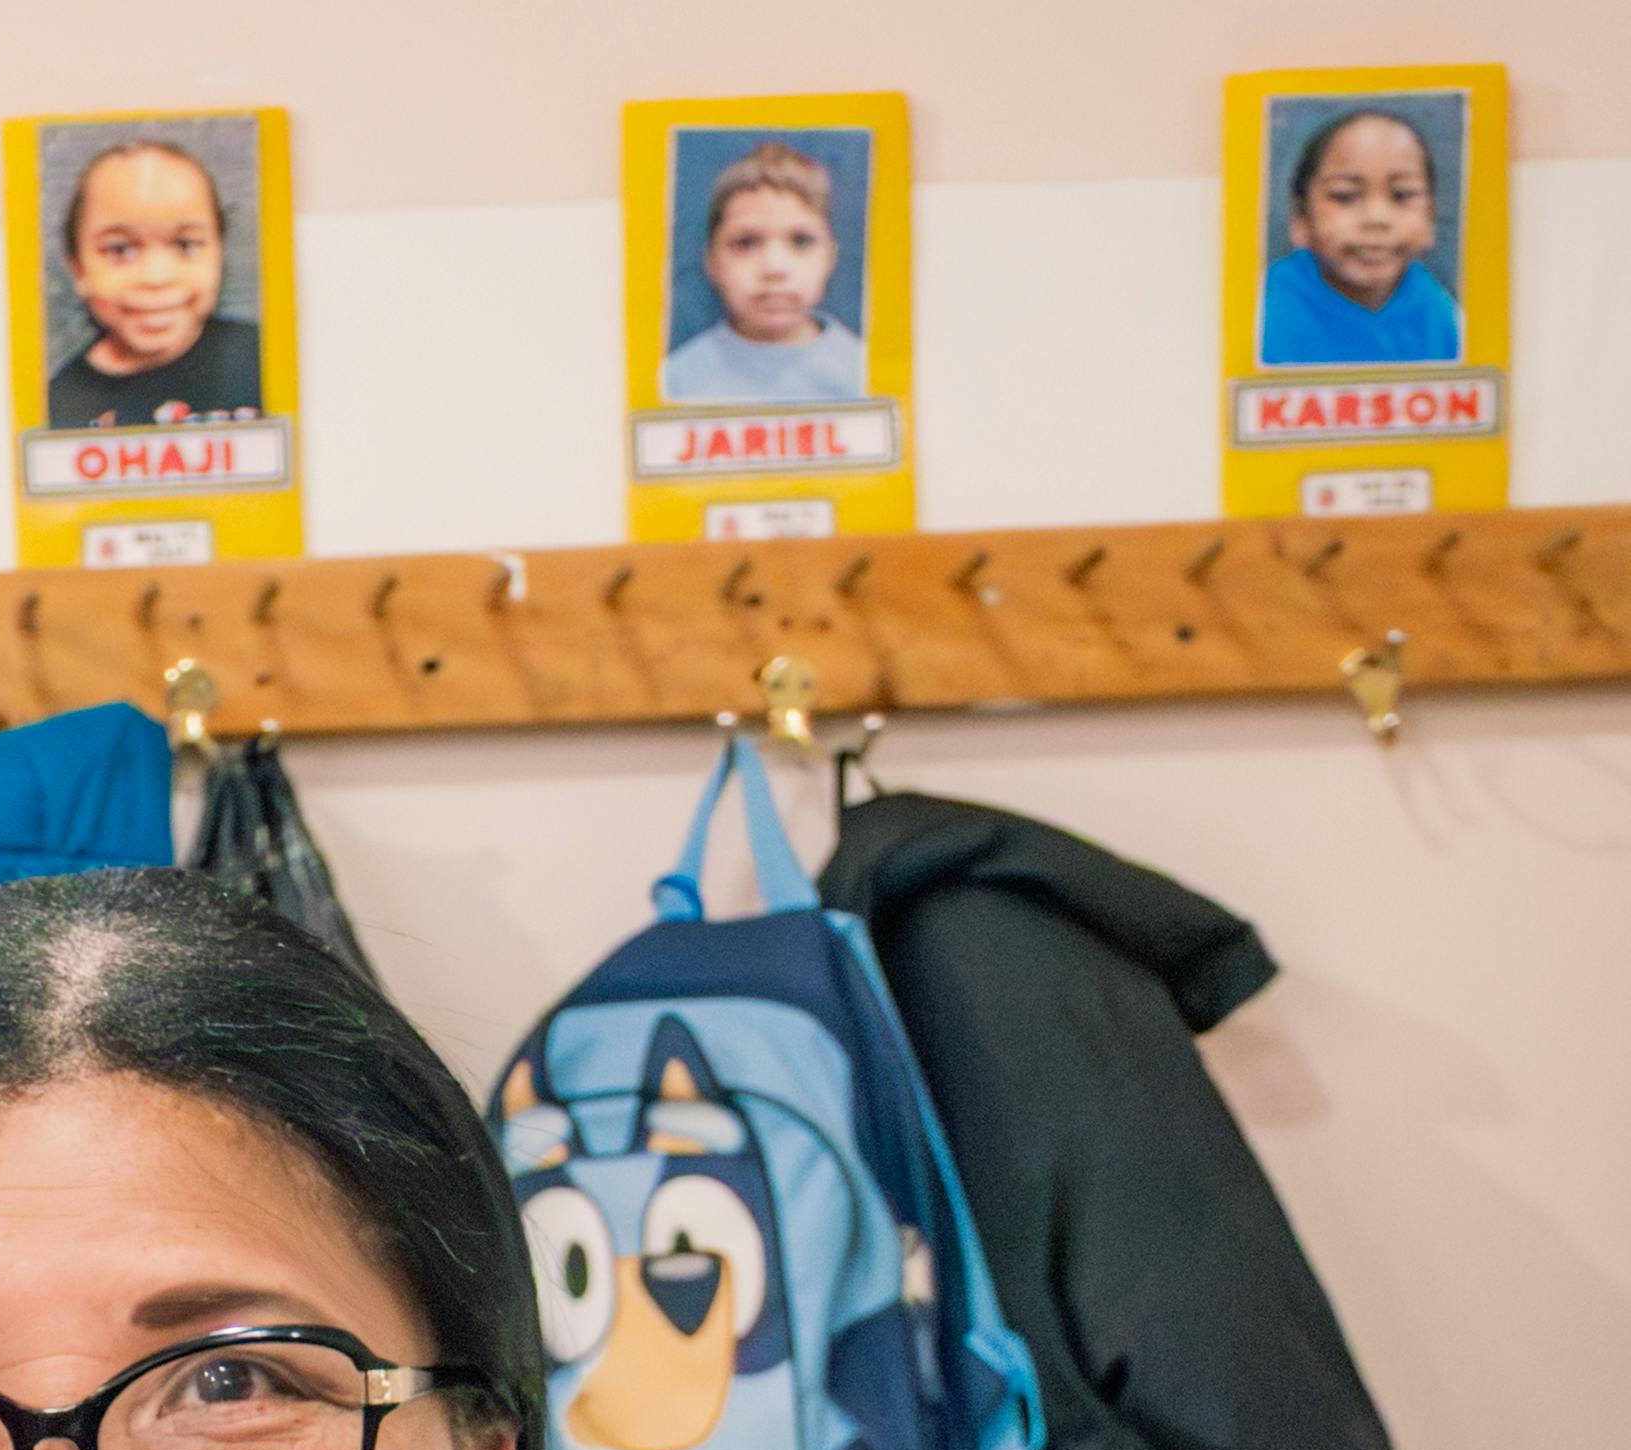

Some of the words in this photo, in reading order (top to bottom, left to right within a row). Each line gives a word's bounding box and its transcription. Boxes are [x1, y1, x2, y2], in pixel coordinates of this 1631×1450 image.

[1260, 388, 1479, 429] KARSON
[75, 440, 234, 480] OHAJI
[677, 423, 847, 463] JARIEL
